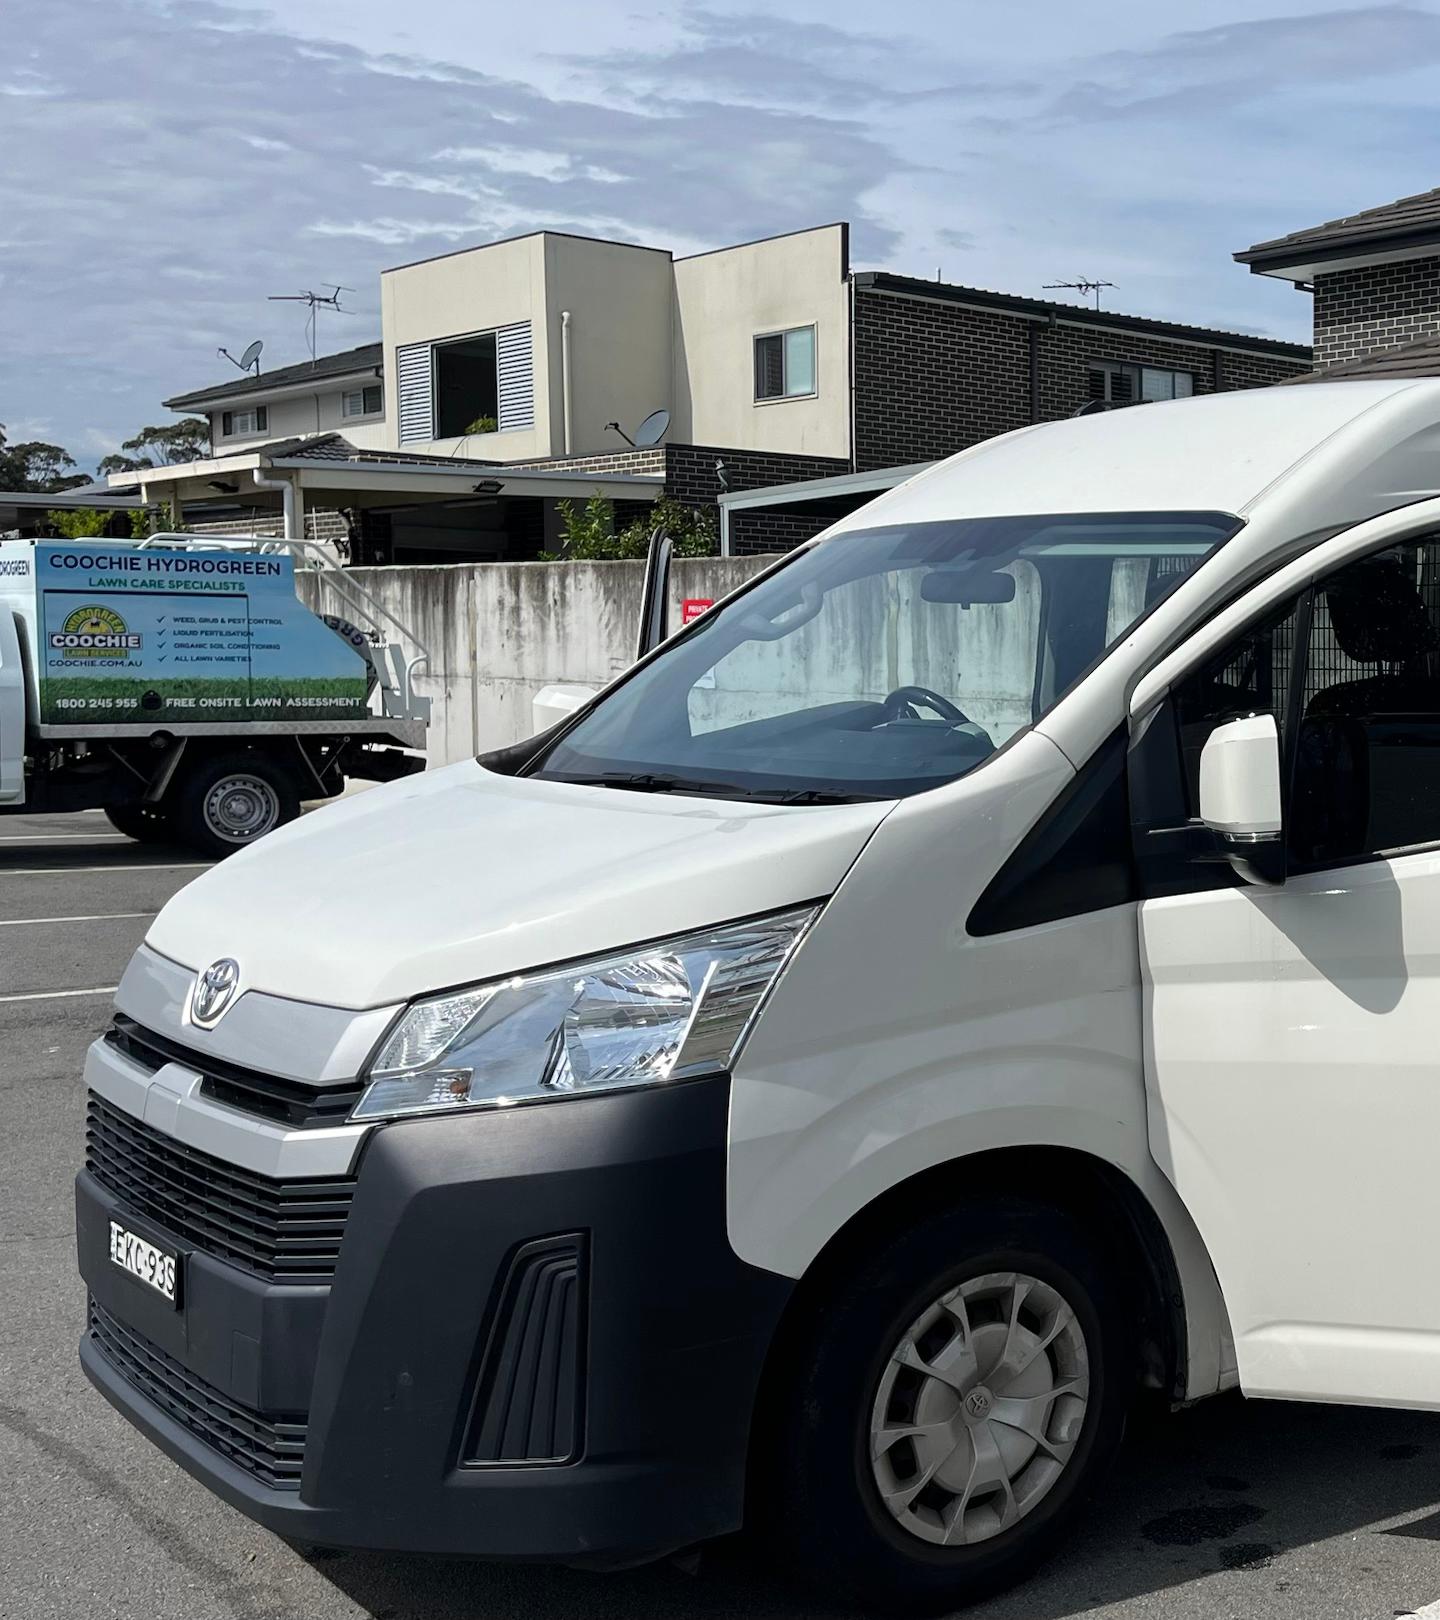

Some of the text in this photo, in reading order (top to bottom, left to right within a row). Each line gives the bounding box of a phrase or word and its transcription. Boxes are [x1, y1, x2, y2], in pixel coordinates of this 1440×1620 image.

[49, 554, 281, 575] COOCHIE HYDROGREEN
[88, 577, 246, 591] LAWN CARE SPECIALISTS
[52, 635, 140, 648] COOCHIE
[49, 659, 143, 667] COOCHIE.COM.AU
[56, 698, 138, 708] 1800 245 955
[165, 697, 362, 708] FREE ONSITE LAWN ASSESSMENT
